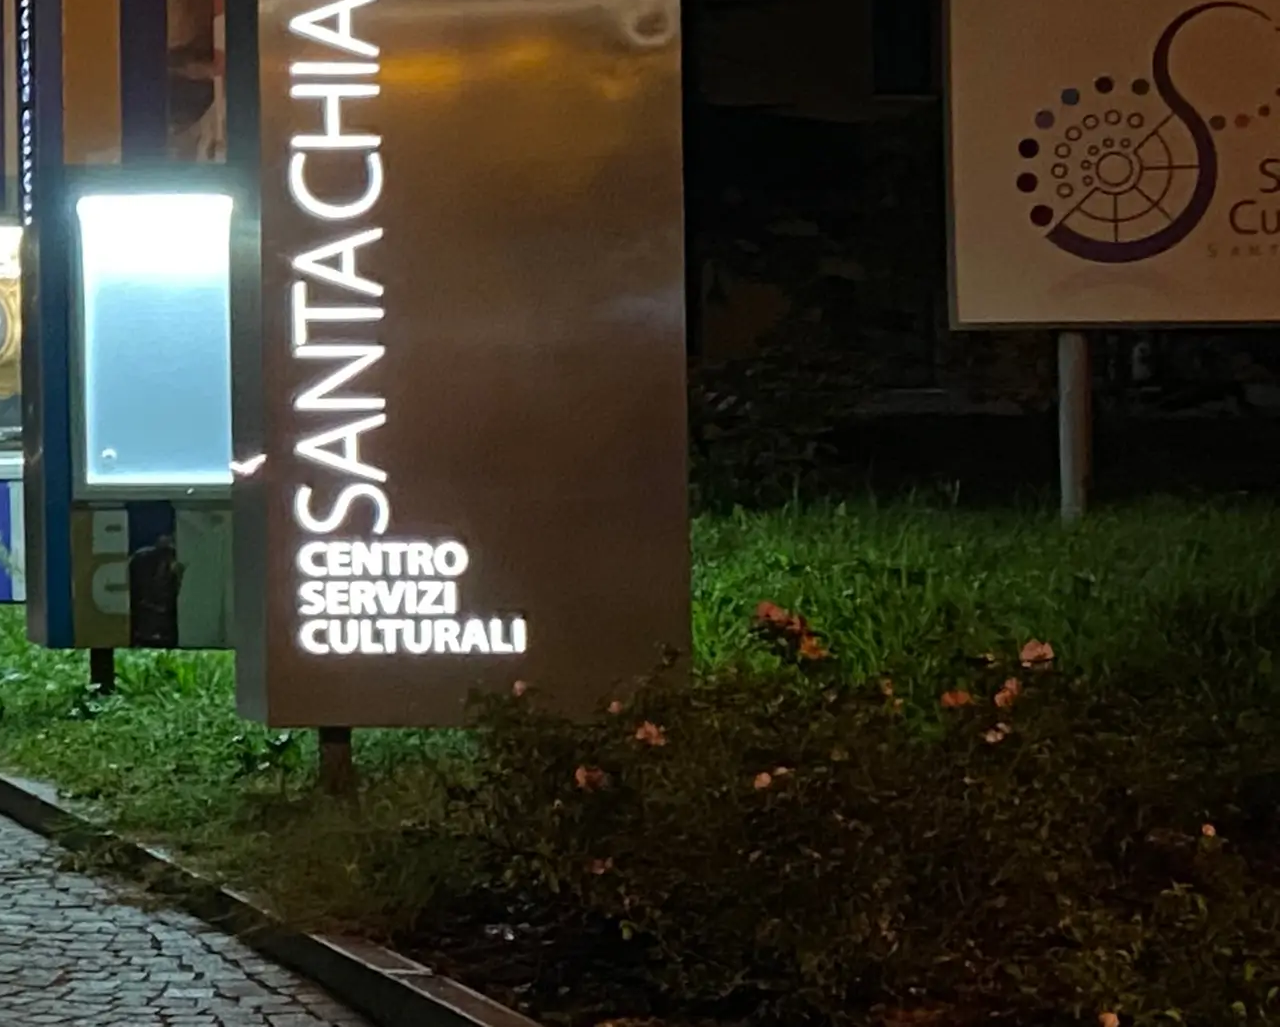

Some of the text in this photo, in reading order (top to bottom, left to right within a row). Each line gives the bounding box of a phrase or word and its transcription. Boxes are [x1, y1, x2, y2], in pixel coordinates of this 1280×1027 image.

[298, 541, 469, 577] CENTRO
[299, 580, 458, 616] SERVIZI
[299, 617, 527, 654] CULTURALI
